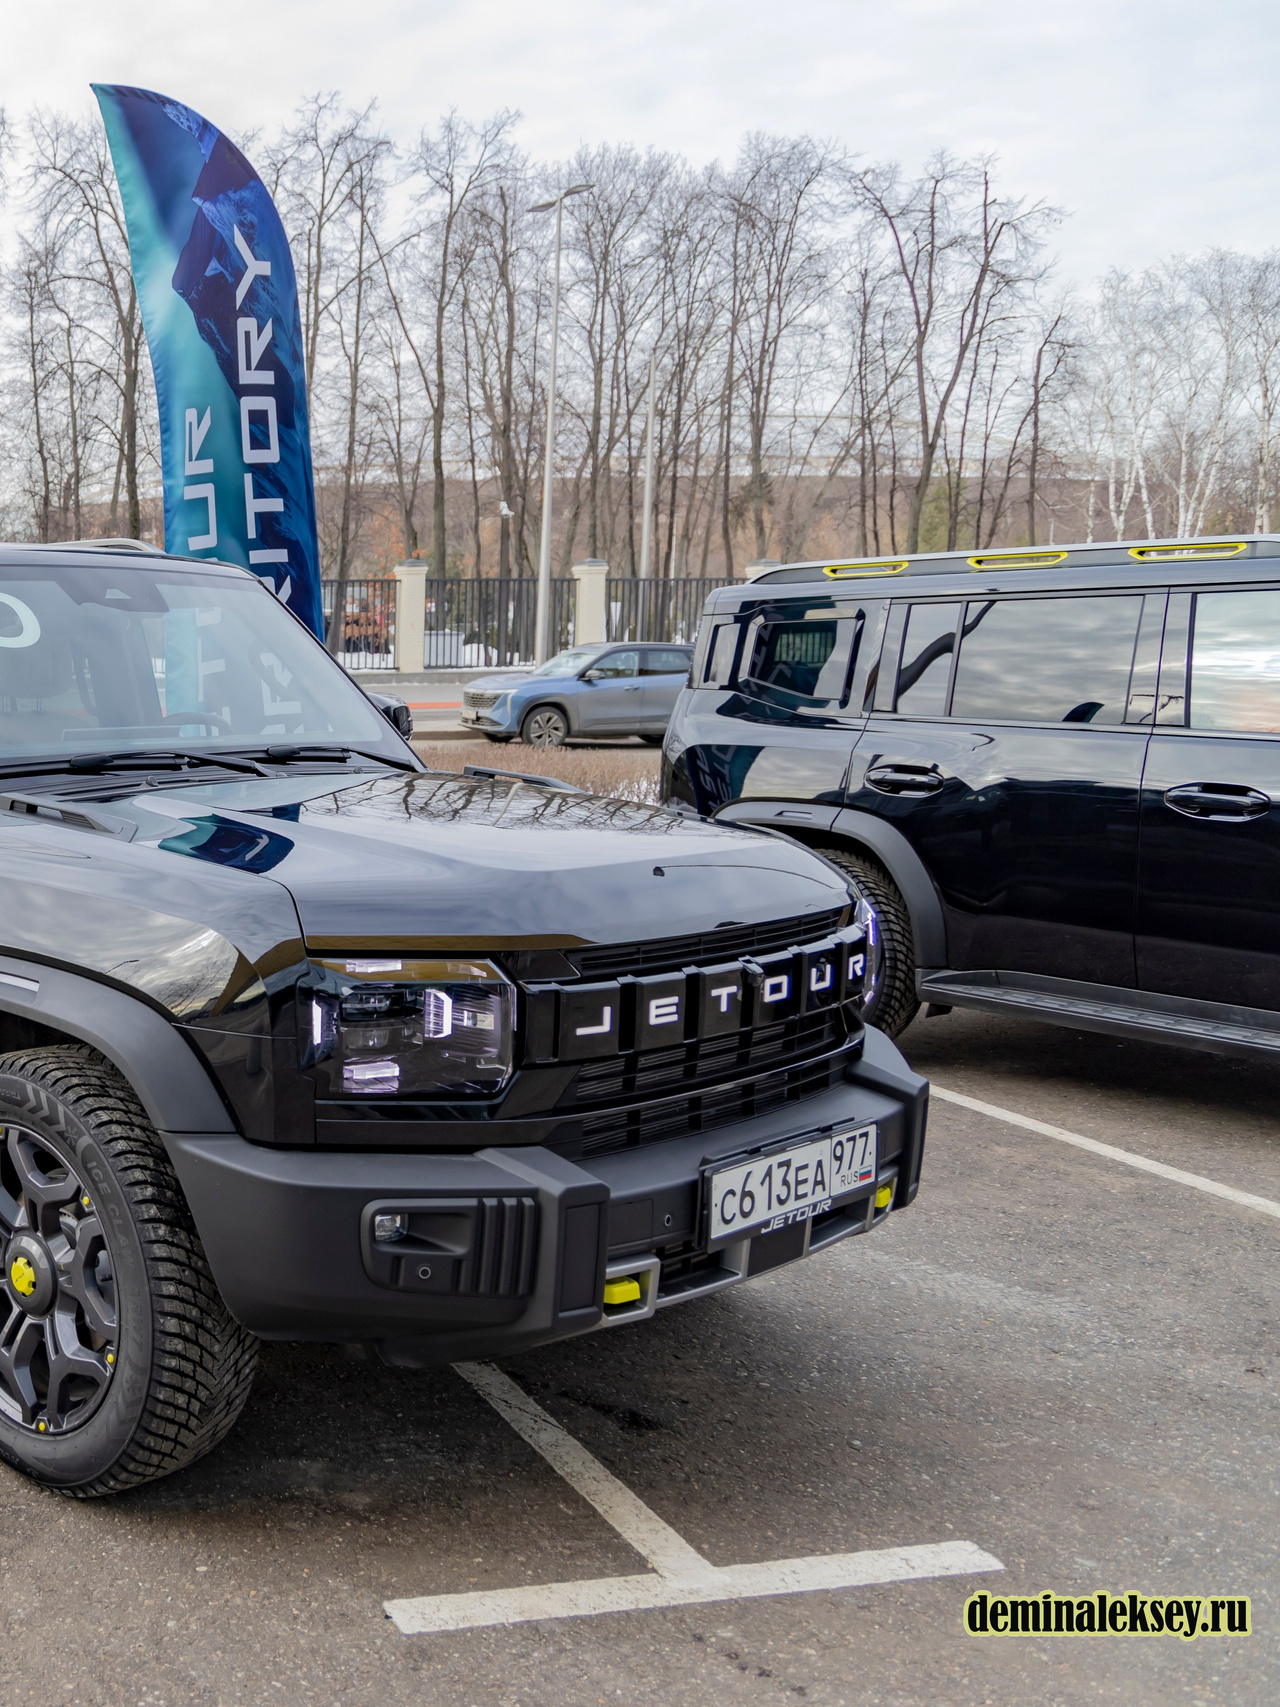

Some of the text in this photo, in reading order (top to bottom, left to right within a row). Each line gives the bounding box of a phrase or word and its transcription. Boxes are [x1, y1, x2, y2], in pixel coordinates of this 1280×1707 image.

[184, 405, 217, 561] UR
[575, 953, 864, 1035] JETOUR
[833, 1131, 869, 1175] 977
[87, 1162, 111, 1195] ICE
[840, 1170, 858, 1187] RUS
[761, 1199, 832, 1234] JETOUR
